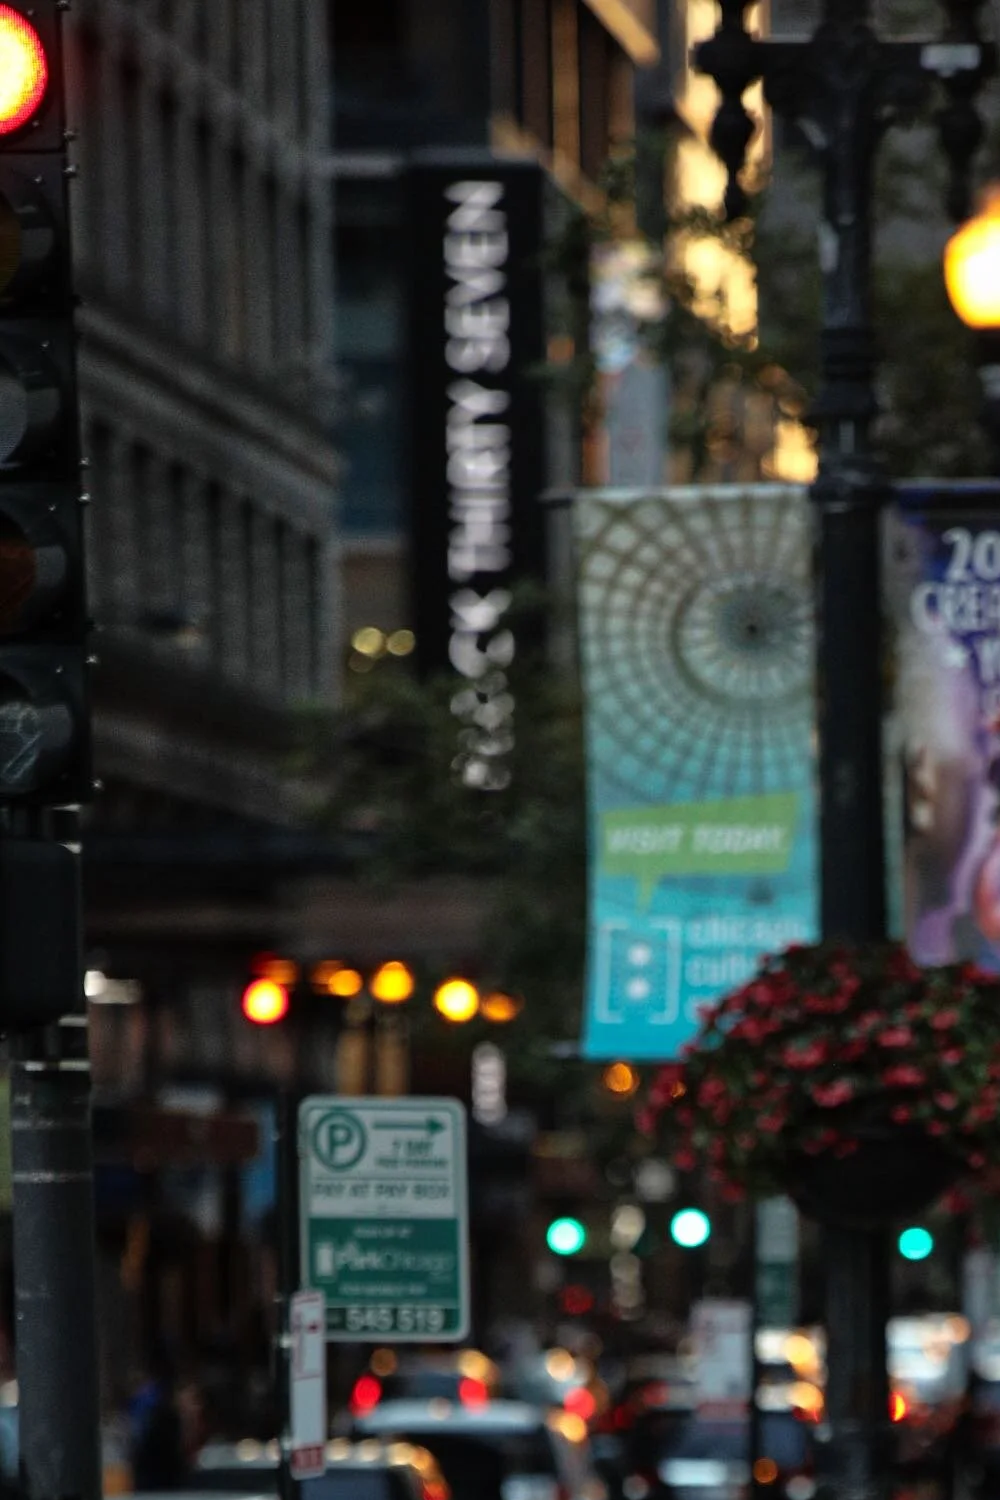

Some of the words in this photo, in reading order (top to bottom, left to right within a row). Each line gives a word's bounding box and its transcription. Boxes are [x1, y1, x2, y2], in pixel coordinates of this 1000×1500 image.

[444, 180, 510, 373] SEVEN
[446, 379, 511, 583] THIRTY
[326, 1122, 353, 1164] P
